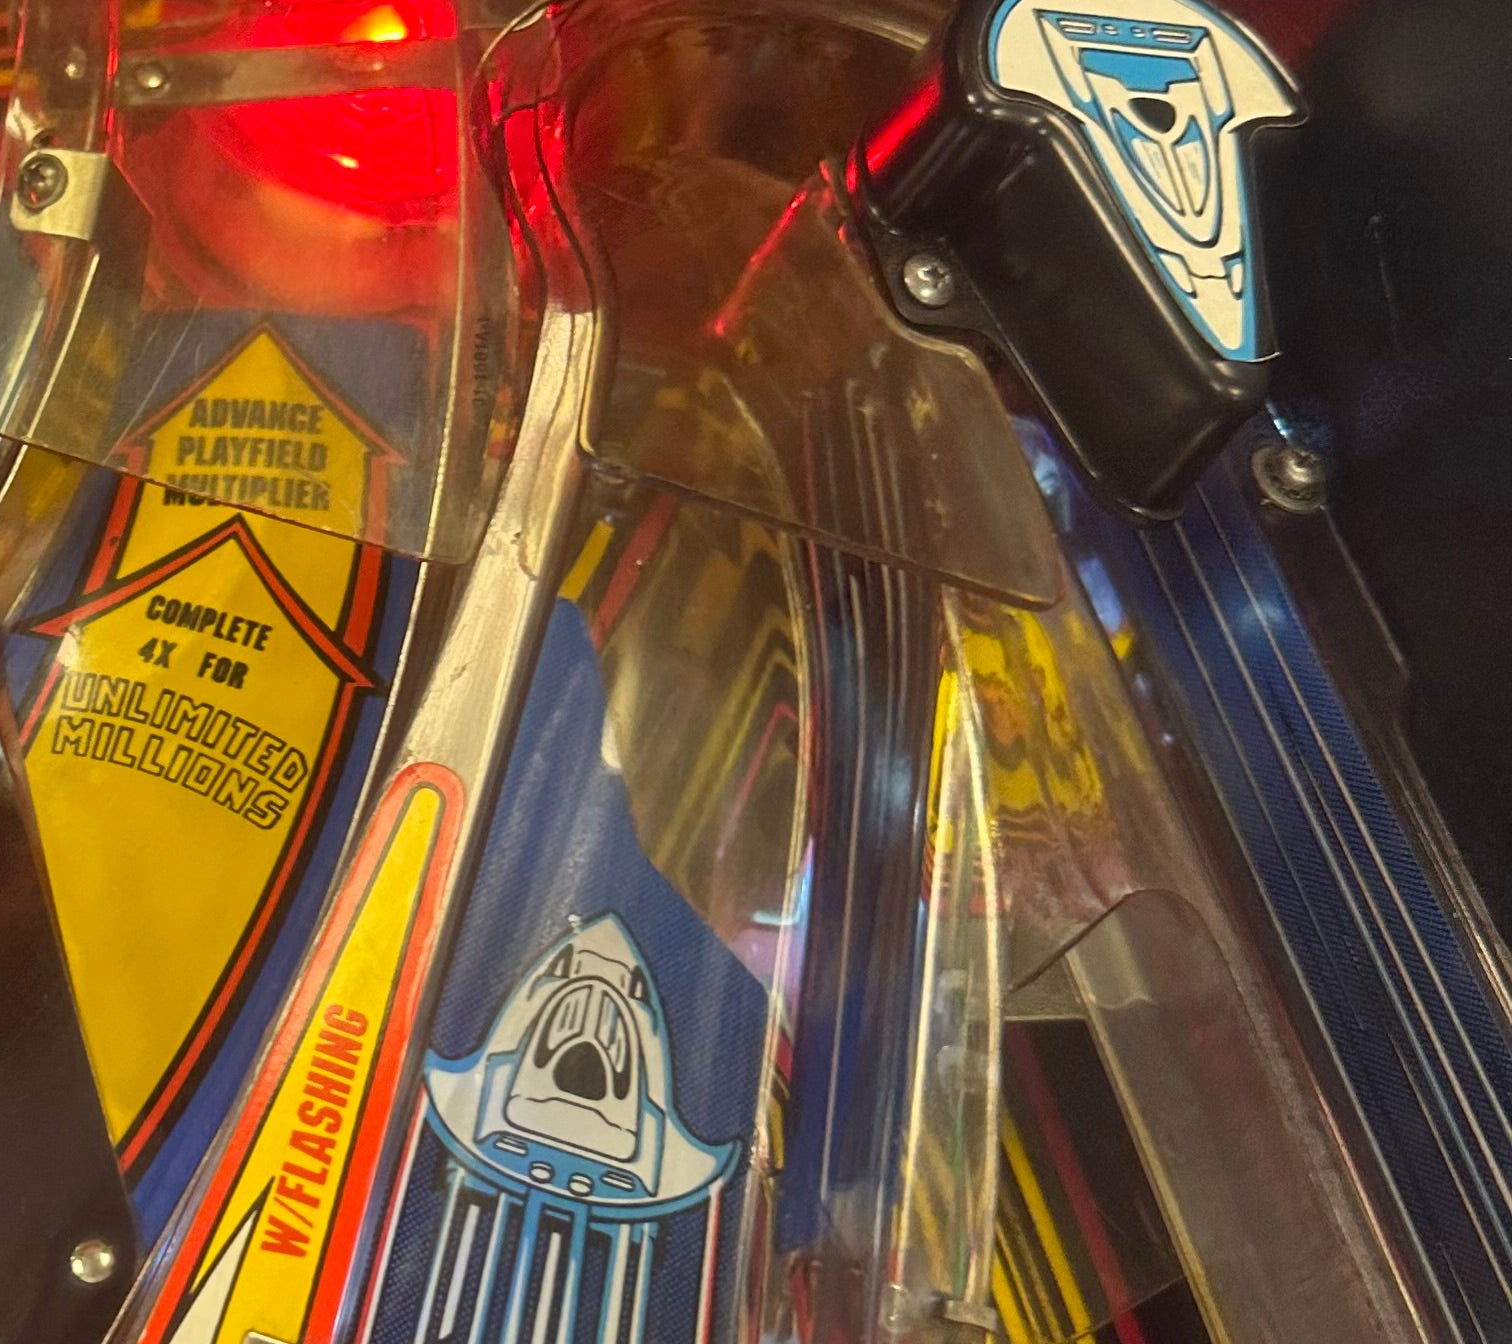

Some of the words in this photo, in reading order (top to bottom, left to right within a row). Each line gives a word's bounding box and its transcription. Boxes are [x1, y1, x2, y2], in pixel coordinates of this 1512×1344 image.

[189, 399, 324, 435] ADVANCE
[176, 436, 329, 471] PLAYFIELD
[162, 473, 331, 511] MULTIPLIER
[145, 594, 273, 652] COMPLETE
[138, 637, 177, 669] 4X
[197, 652, 248, 690] FOR
[62, 672, 310, 792] UNLIMITED
[51, 716, 291, 831] MILLIONS
[260, 1003, 369, 1258] W/FLASHING
